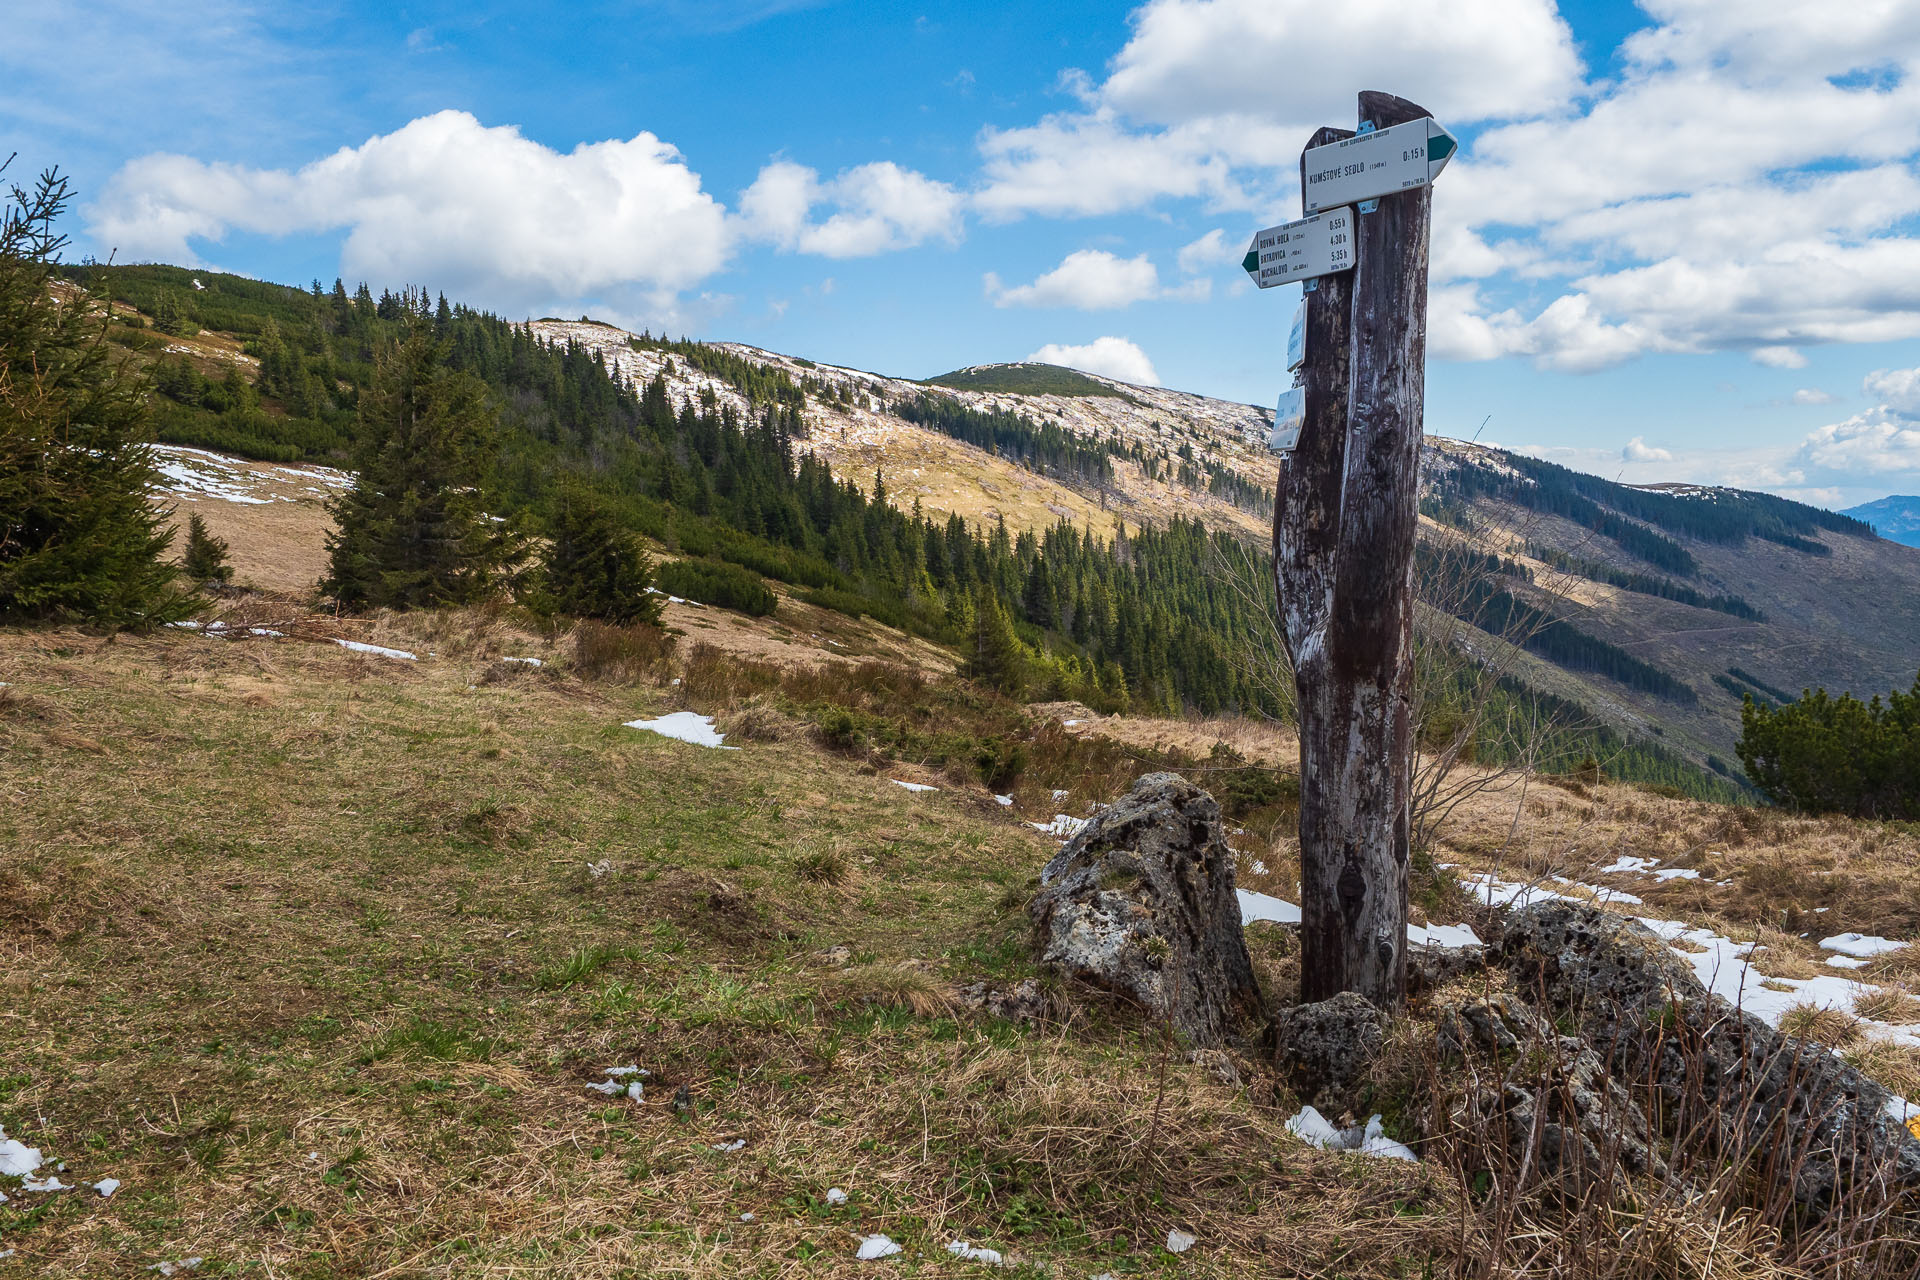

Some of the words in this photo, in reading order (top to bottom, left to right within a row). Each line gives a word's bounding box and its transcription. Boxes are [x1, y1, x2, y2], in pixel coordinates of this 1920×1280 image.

[1403, 147, 1419, 162] 0:15
[1420, 146, 1425, 157] h
[1309, 165, 1341, 185] KUMŠTOVÉ
[1344, 162, 1365, 177] SEDLO
[1329, 218, 1341, 231] 0:55
[1260, 235, 1275, 249] ROVNÁ
[1330, 234, 1342, 246] 4:30
[1331, 249, 1343, 262] 5:35
[1261, 264, 1288, 279] MICHALOVO
